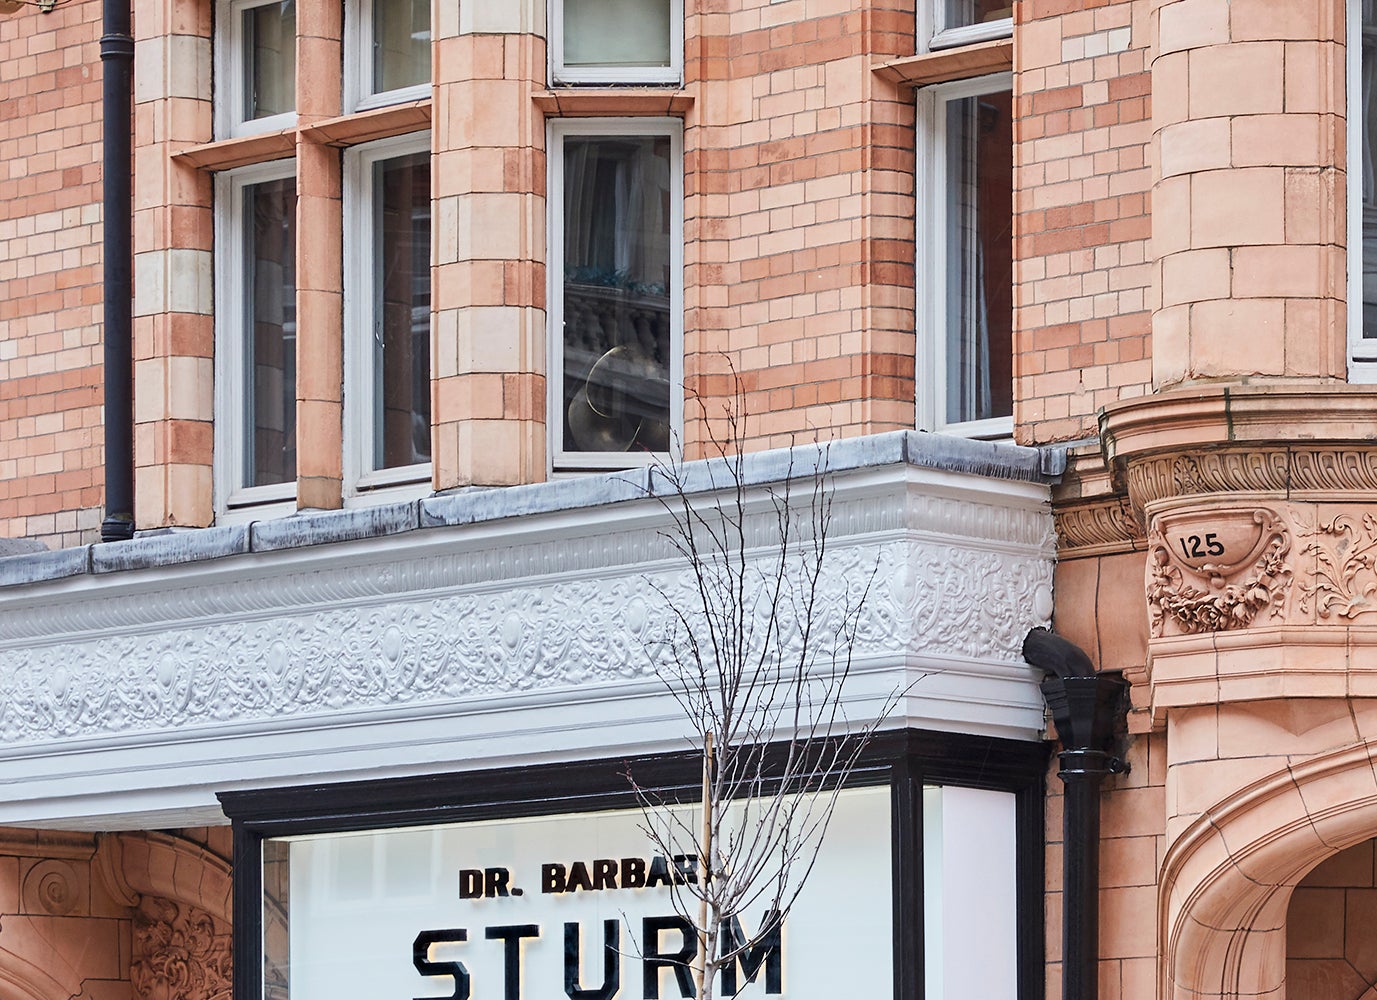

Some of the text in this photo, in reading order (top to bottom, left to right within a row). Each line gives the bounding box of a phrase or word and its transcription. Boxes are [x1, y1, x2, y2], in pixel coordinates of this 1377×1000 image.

[1179, 533, 1225, 559] 125
[459, 853, 727, 899] DR. BARBAR
